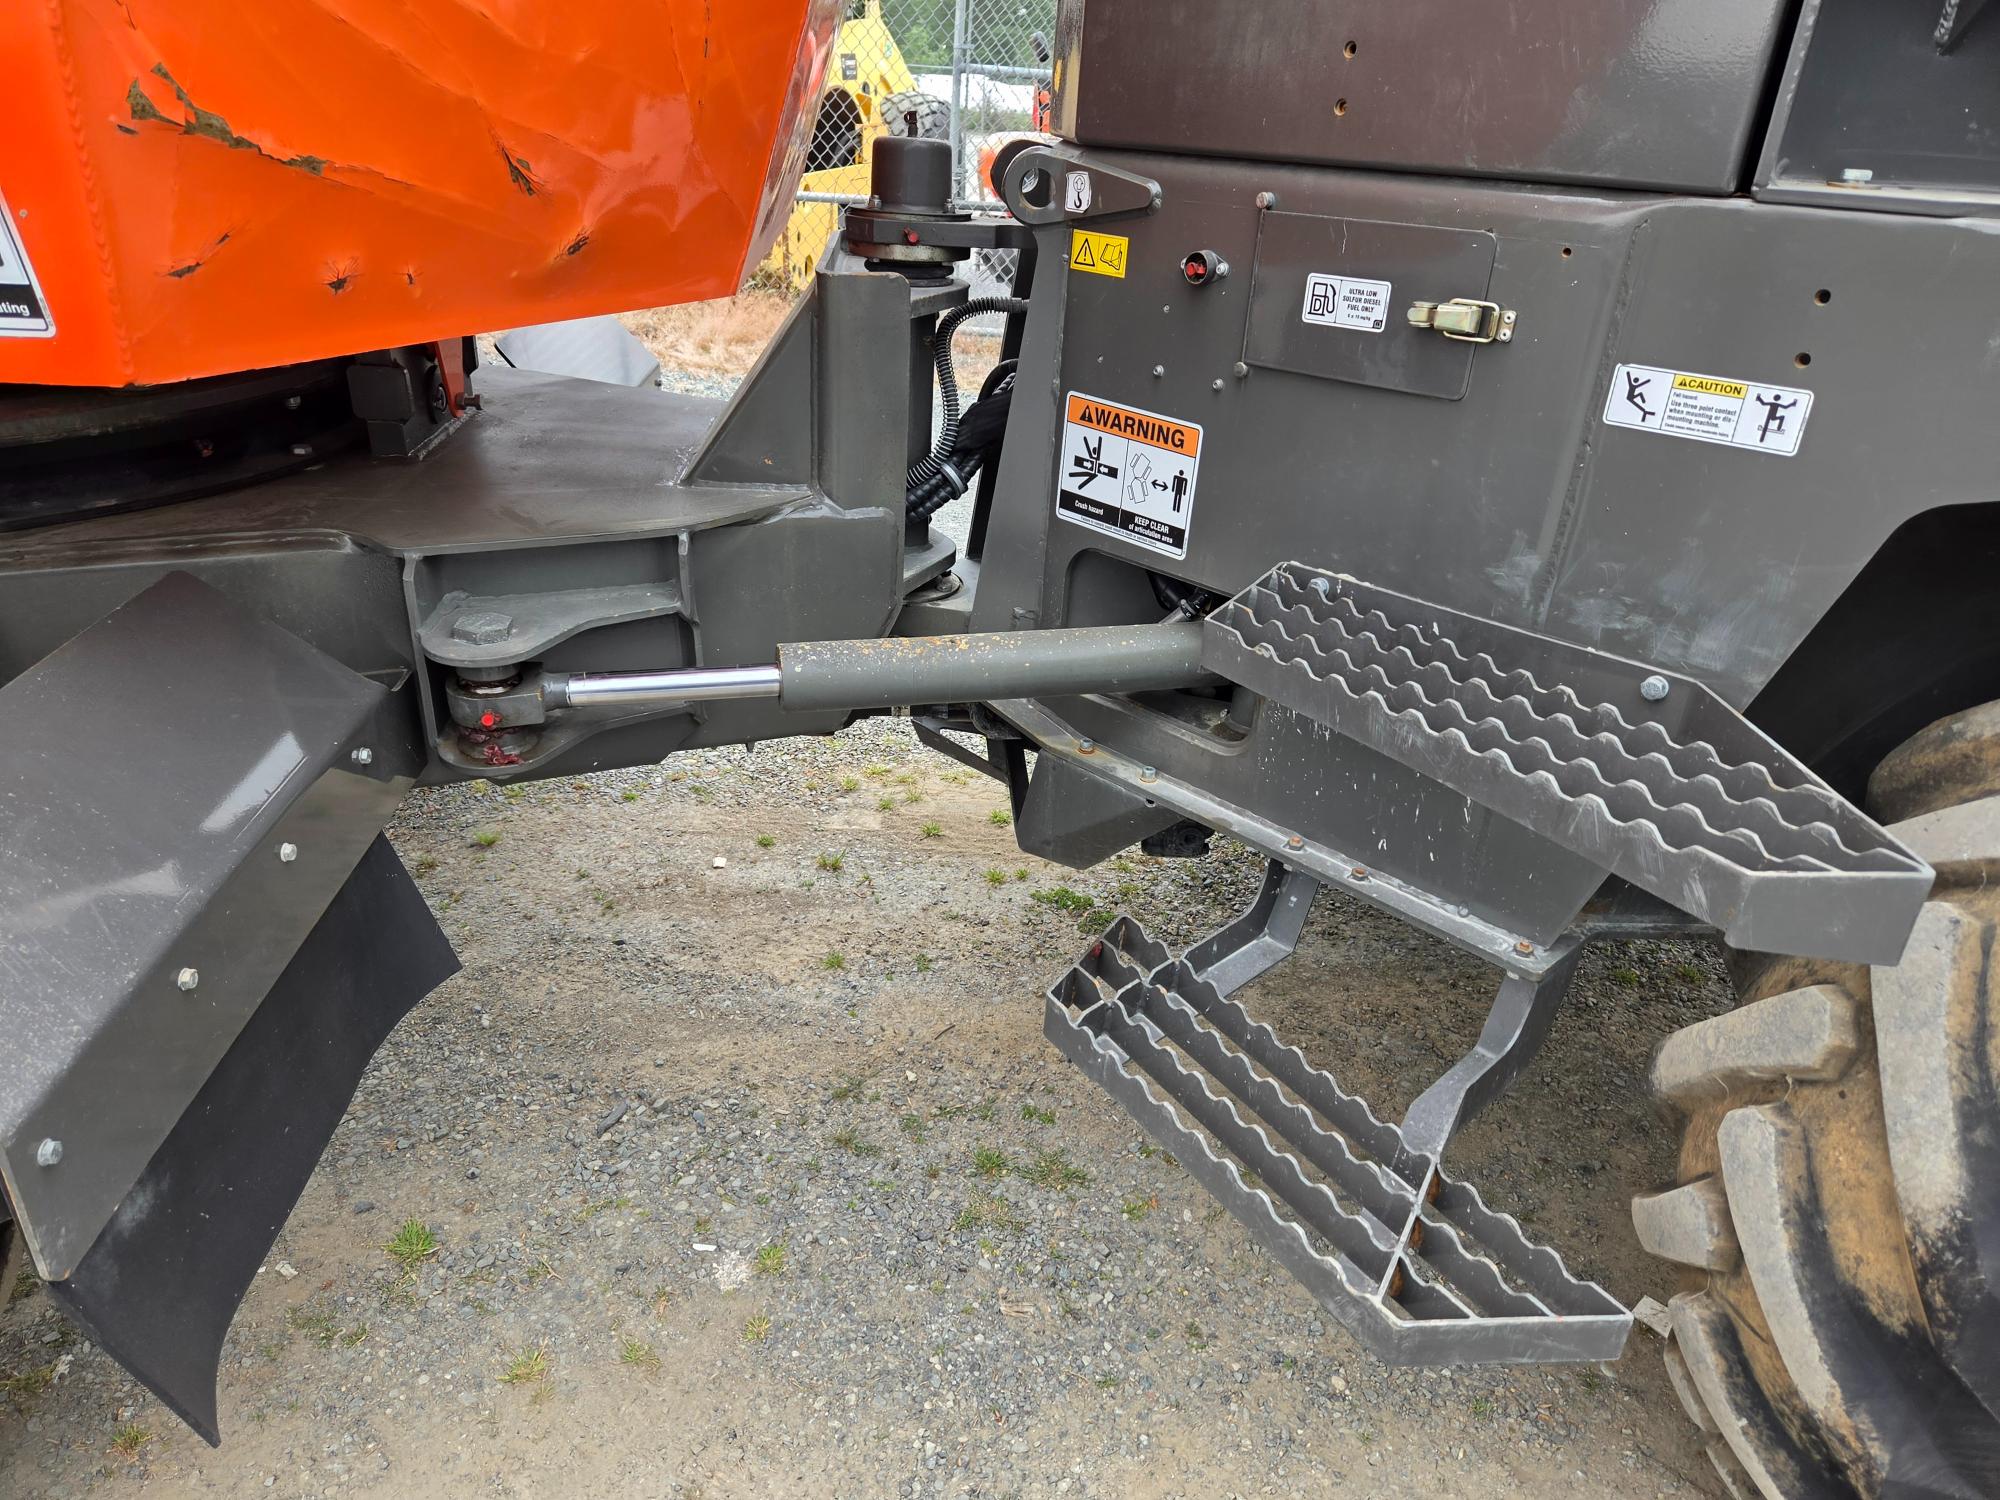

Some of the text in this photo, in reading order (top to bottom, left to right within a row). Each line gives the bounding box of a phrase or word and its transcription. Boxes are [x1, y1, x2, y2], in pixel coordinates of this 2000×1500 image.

[1349, 288, 1365, 297] ULTRA
[1342, 295, 1381, 306] SULFUR DIESEL
[1347, 304, 1360, 312] FUEL
[0, 301, 30, 316] ting
[1688, 379, 1742, 395] CAUTION
[1671, 399, 1737, 416] Use three point contact
[1667, 414, 1693, 425] mounting
[1685, 410, 1713, 421] mounting
[1095, 406, 1185, 449] WARNING
[1074, 500, 1104, 515] Crush hazard
[1135, 515, 1150, 527] KEEP
[1150, 520, 1169, 534] CLEAR
[1135, 527, 1161, 540] articulation
[1161, 535, 1173, 544] area
